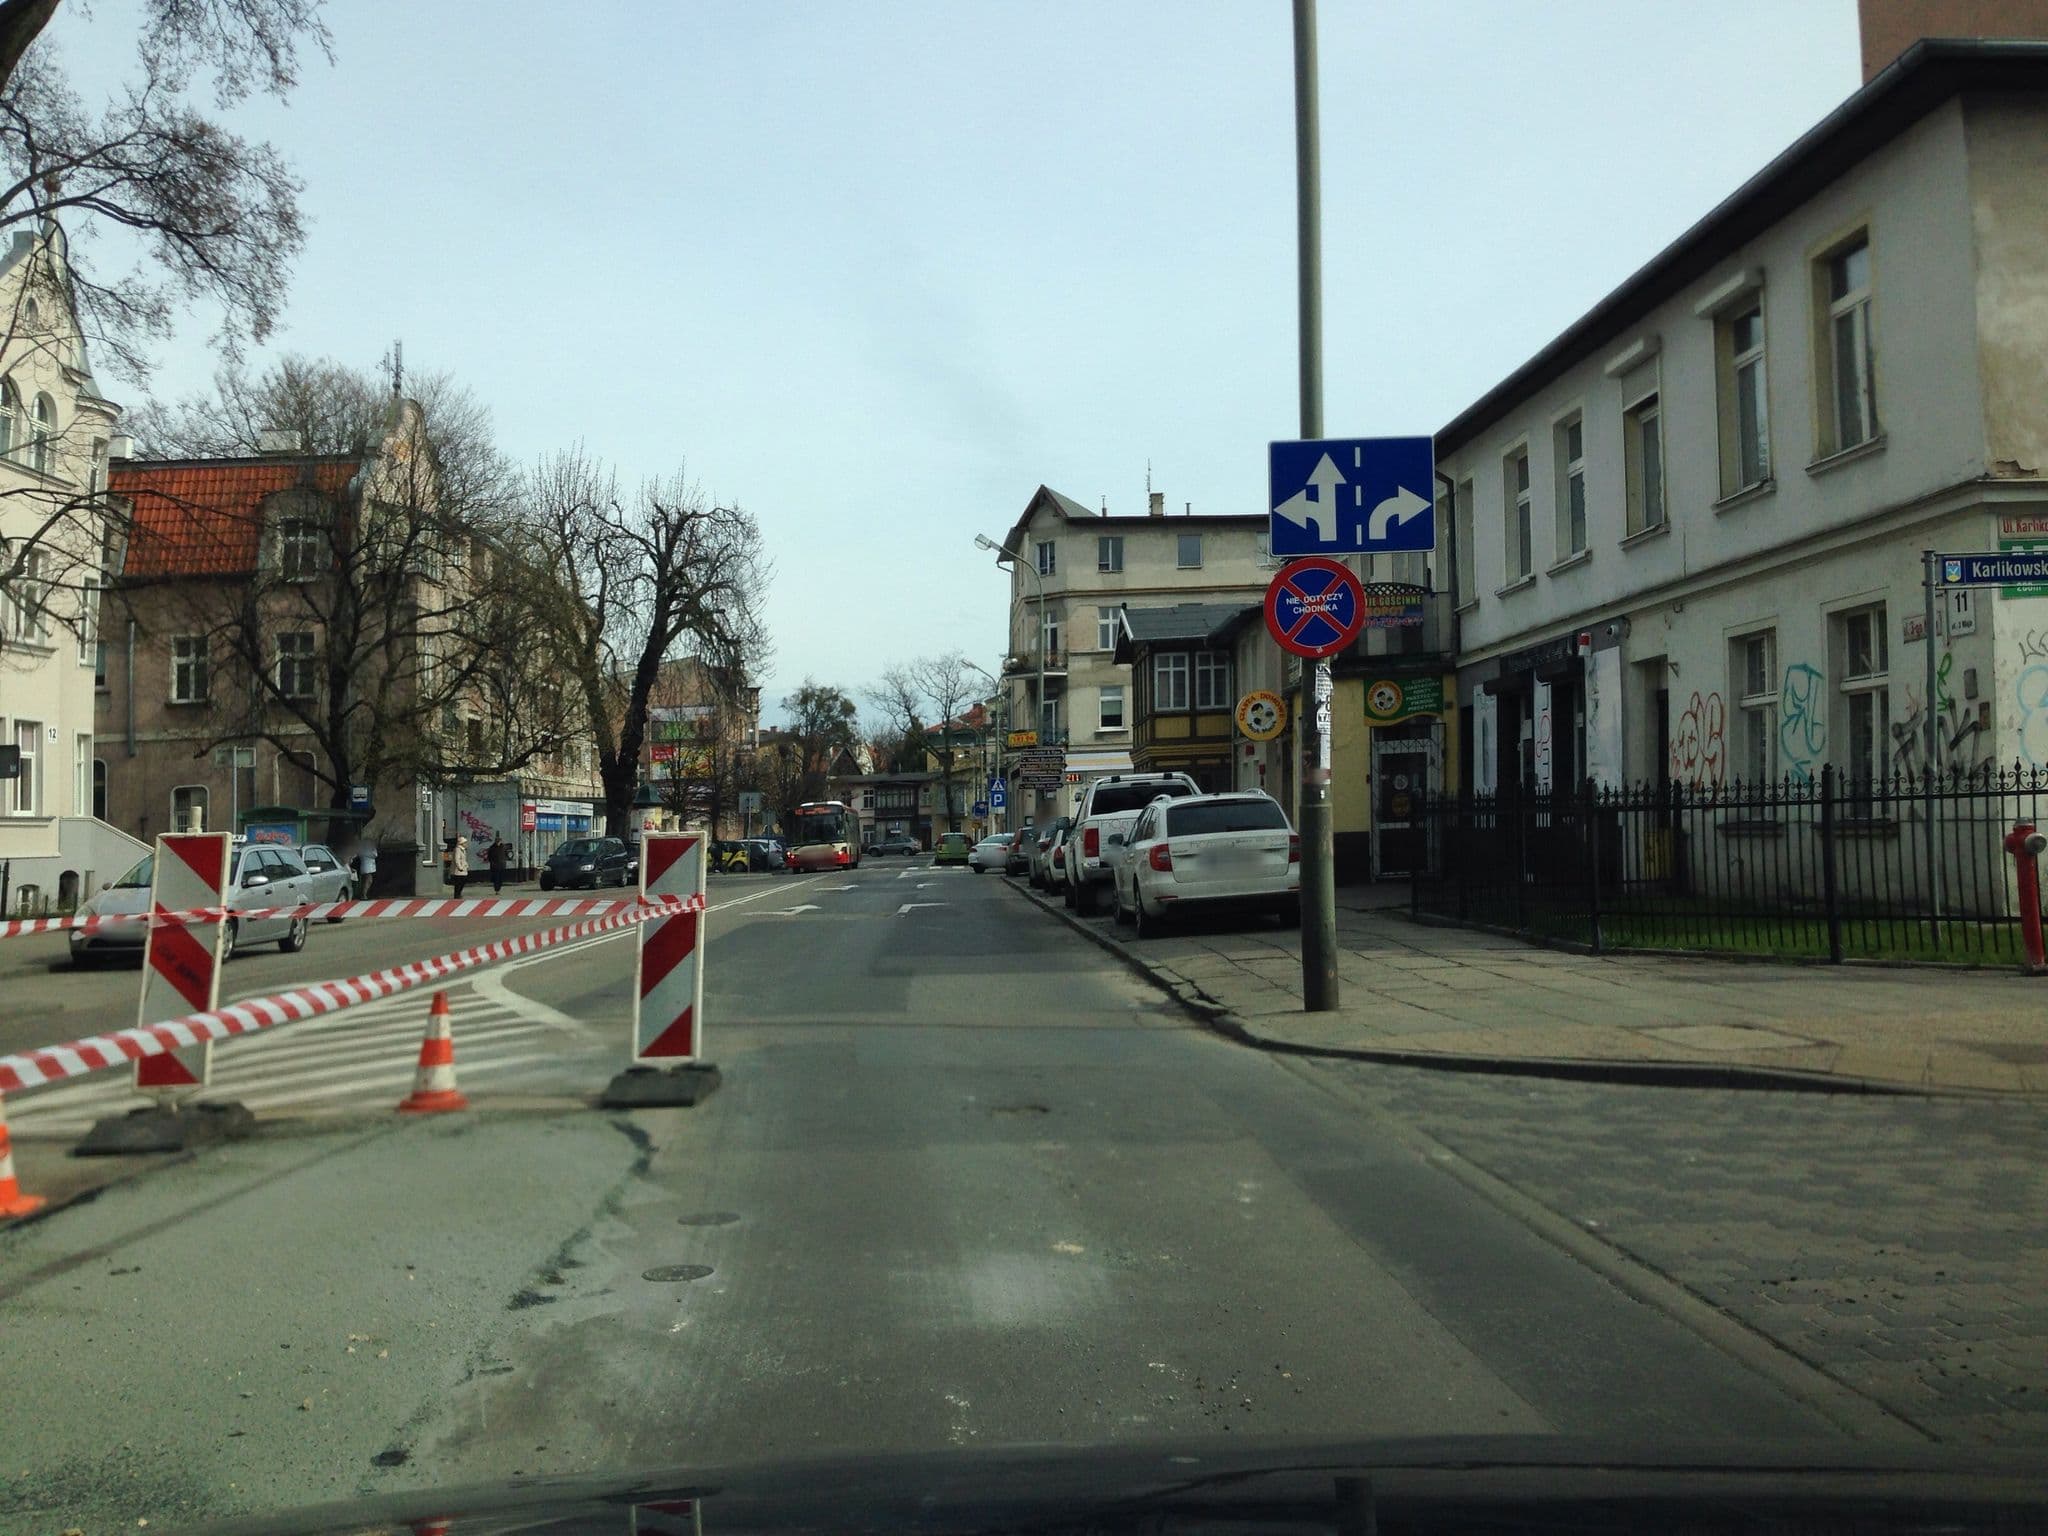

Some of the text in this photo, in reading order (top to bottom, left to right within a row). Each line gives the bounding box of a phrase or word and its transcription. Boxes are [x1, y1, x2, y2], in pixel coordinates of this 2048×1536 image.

[1286, 592, 1344, 605] NIE DOTYCZY
[1954, 591, 1968, 613] 11
[1293, 603, 1338, 614] CHODNIKA
[49, 727, 56, 738] 12
